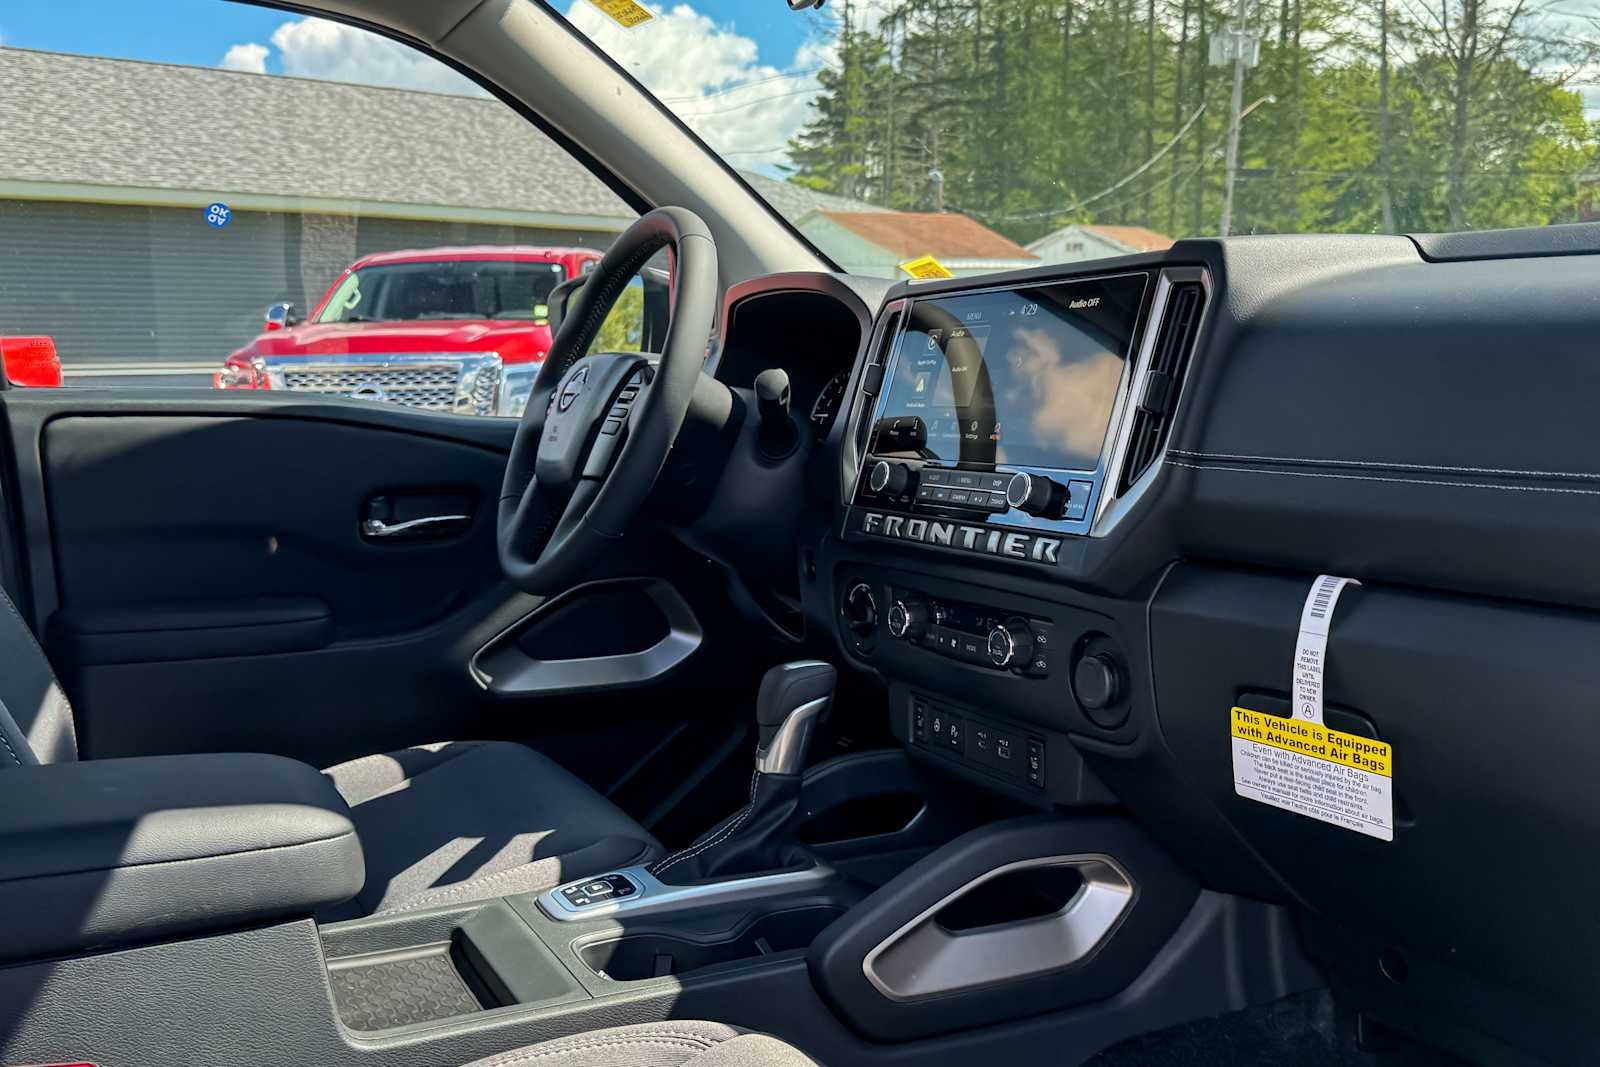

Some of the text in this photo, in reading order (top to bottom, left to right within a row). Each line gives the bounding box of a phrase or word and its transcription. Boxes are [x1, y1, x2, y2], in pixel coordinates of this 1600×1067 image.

[1069, 297, 1101, 309] Audio OFF
[864, 512, 1062, 564] FRONTIER
[1301, 656, 1319, 665] REMOVE
[1296, 678, 1321, 689] DELIVERED
[1235, 710, 1387, 759] This Vehicle is Equipped
[1238, 724, 1385, 773] with Advanced Air Bags
[1253, 743, 1369, 784] Even with Advanced Air Bags
